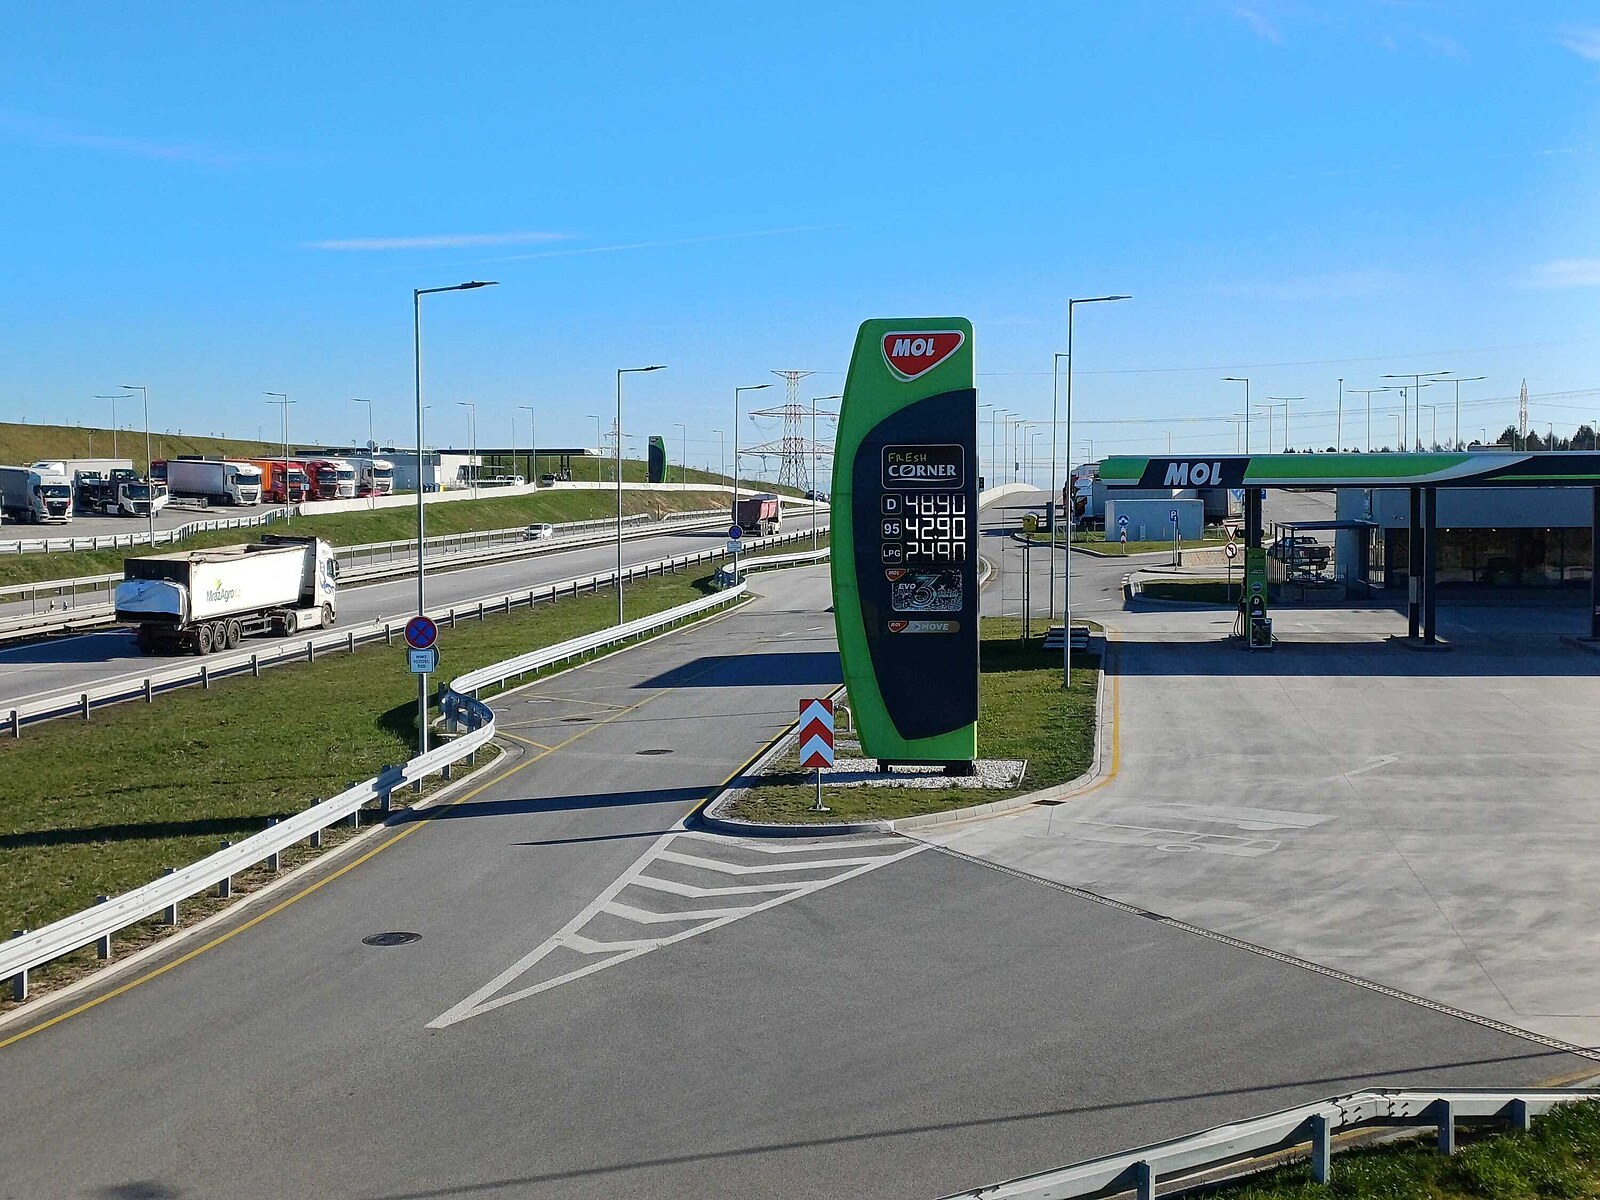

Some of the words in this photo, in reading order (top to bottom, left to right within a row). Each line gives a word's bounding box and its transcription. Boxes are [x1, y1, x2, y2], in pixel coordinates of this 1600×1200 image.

[891, 338, 935, 357] MOL
[888, 452, 927, 463] FRESH
[888, 464, 957, 477] CORNER
[1163, 462, 1222, 486] MOL
[886, 499, 896, 510] D
[884, 523, 900, 535] 95
[905, 517, 966, 539] 42.90
[883, 549, 901, 557] LPG
